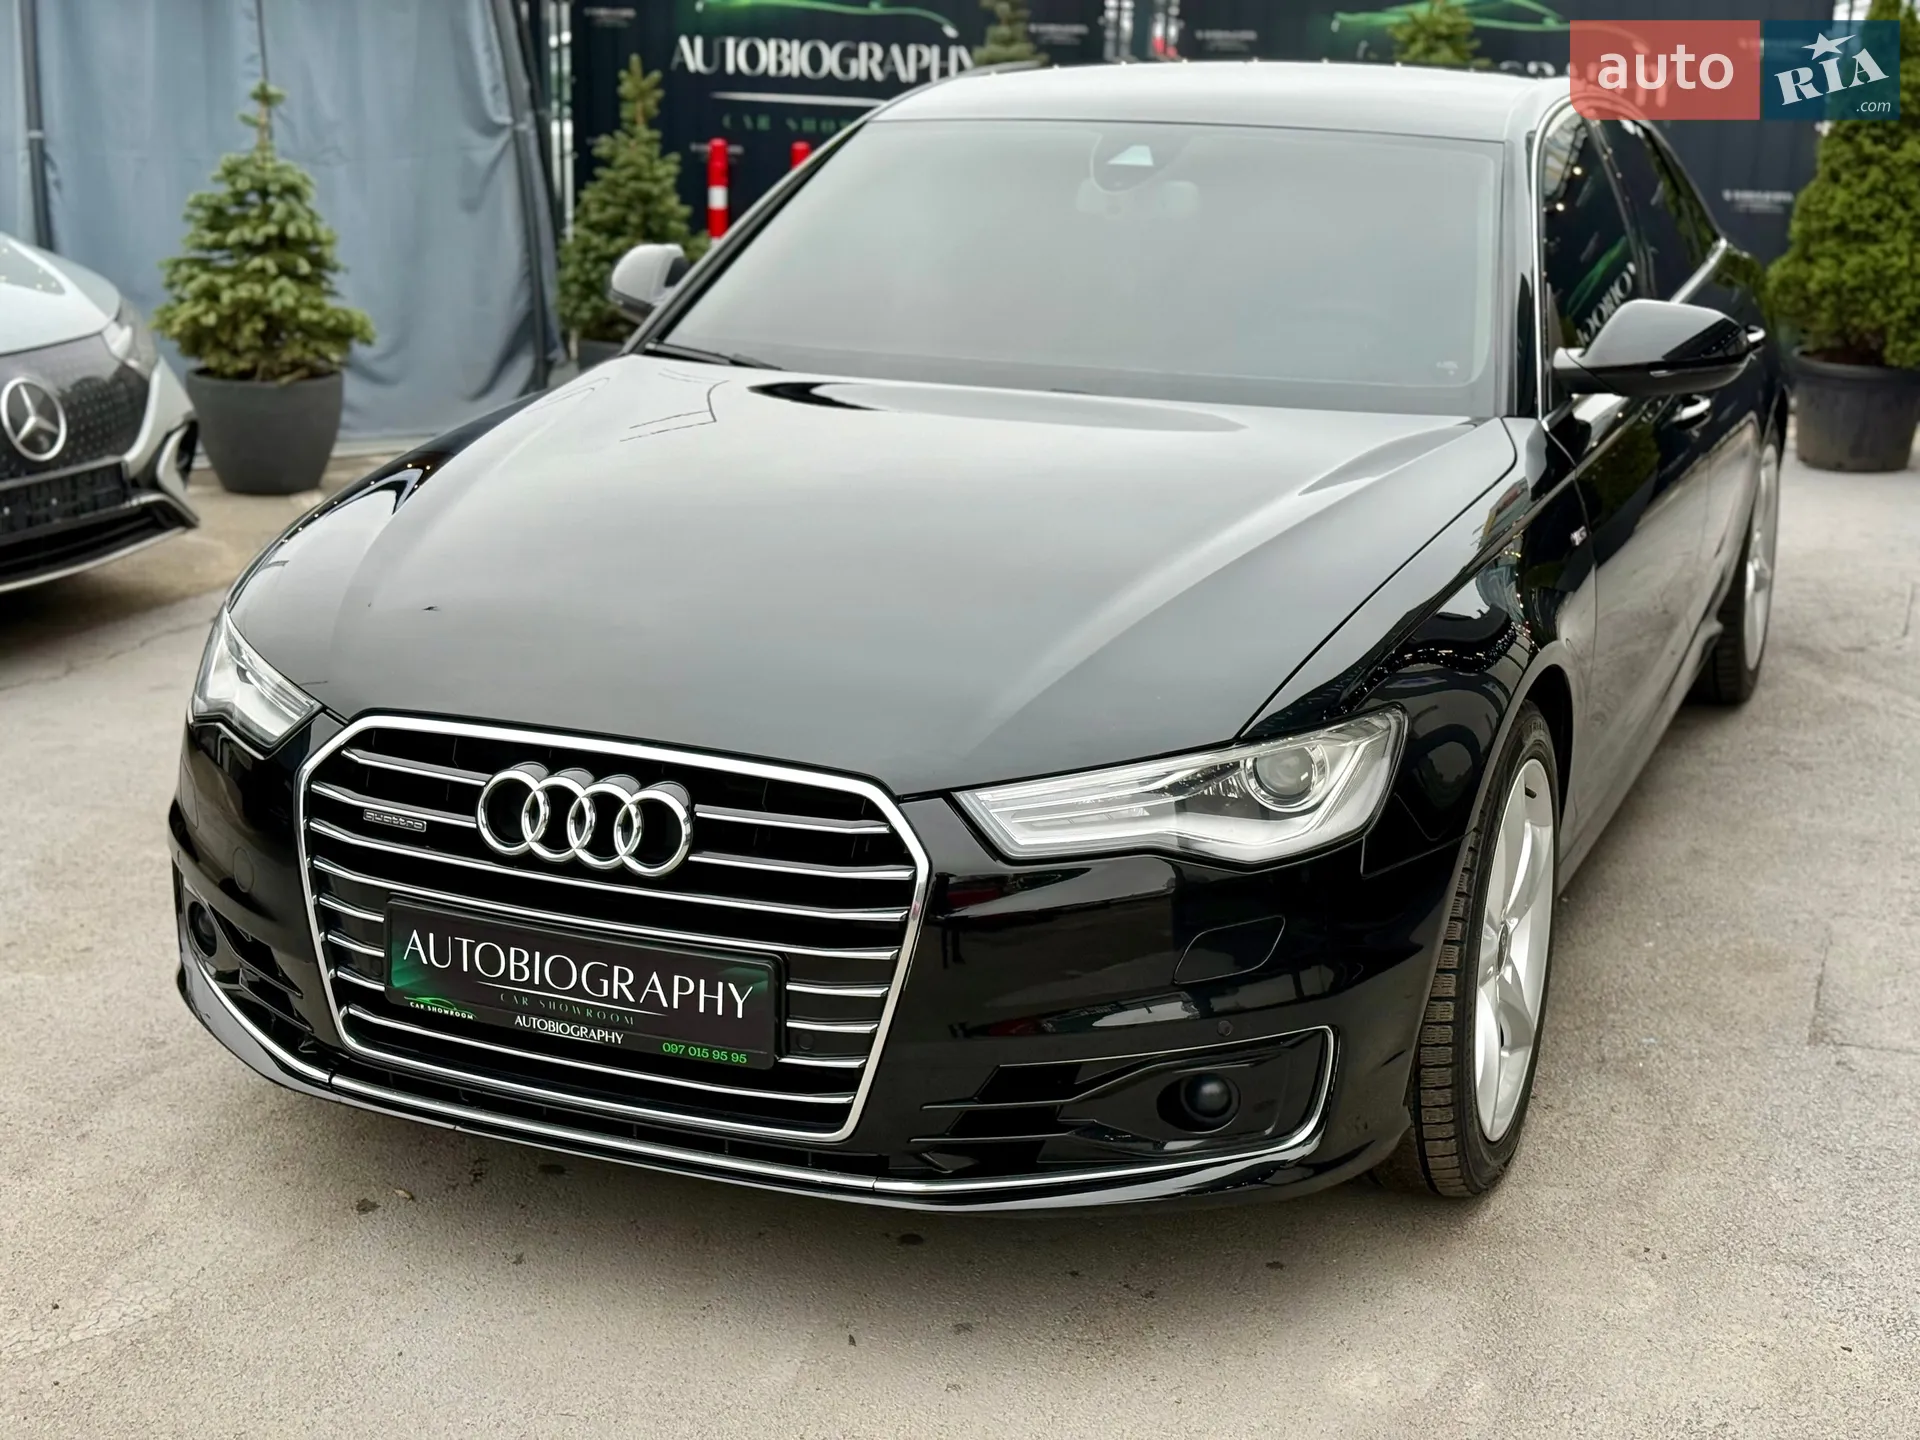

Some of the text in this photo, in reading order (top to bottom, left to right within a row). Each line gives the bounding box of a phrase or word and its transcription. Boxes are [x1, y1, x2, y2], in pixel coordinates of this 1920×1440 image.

[366, 811, 424, 830] quattro
[403, 929, 754, 1019] AUTOBIOGRAPHY
[409, 1001, 474, 1021] CAR SHOWROOM
[500, 992, 634, 1025] CAR SHOWROOM
[514, 1014, 624, 1045] AUTOBIOGRAPHY
[662, 1042, 747, 1064] 097 015 95 95
